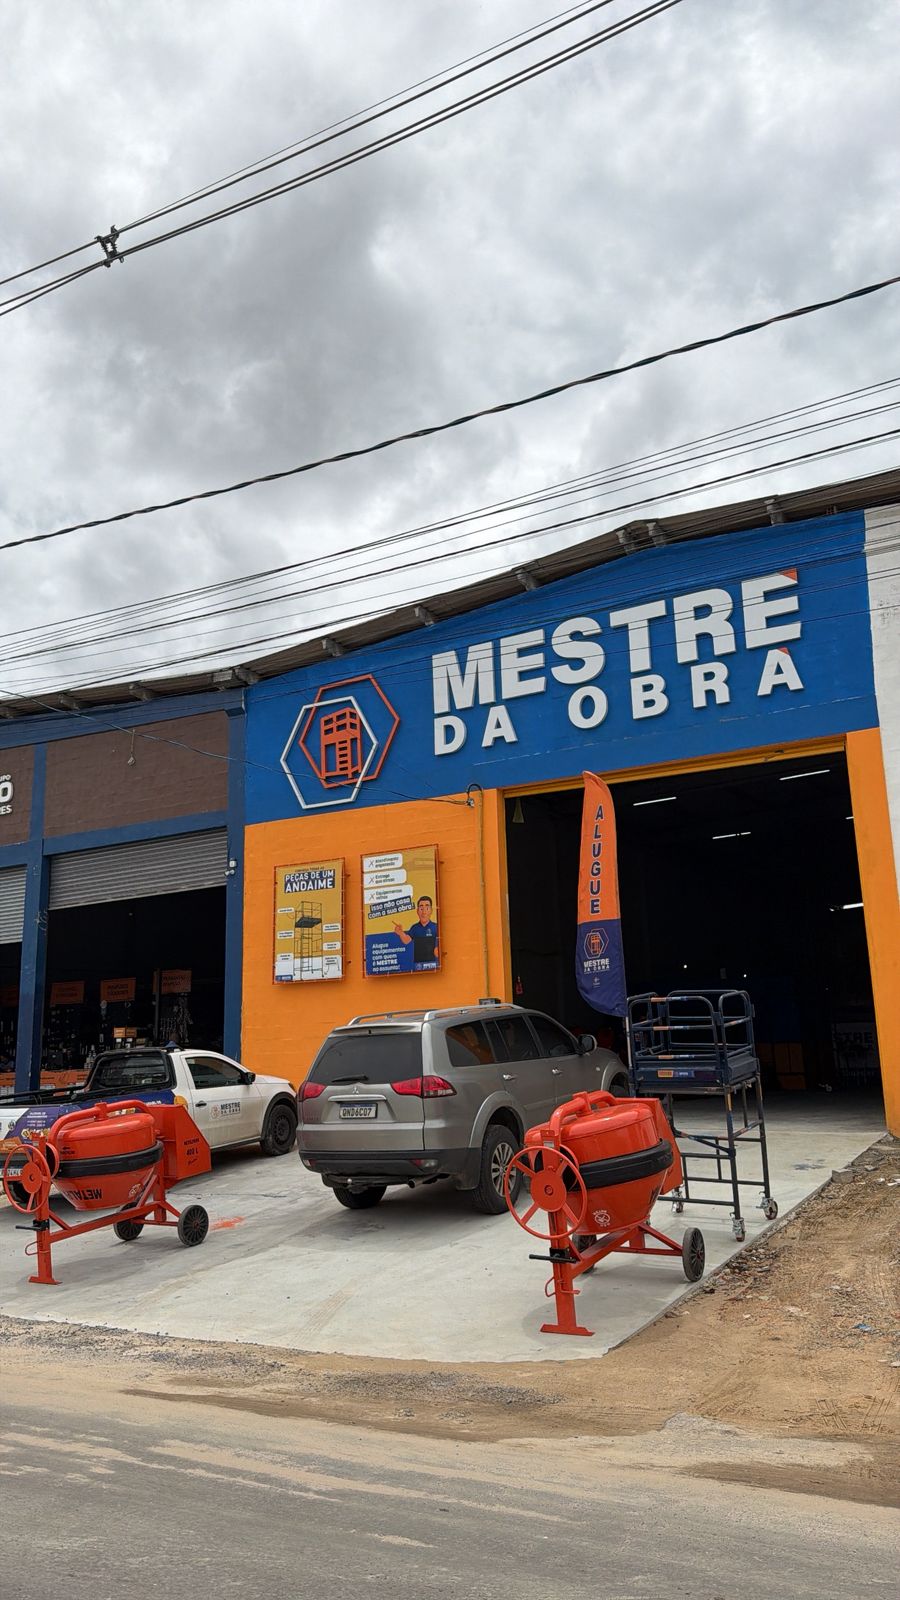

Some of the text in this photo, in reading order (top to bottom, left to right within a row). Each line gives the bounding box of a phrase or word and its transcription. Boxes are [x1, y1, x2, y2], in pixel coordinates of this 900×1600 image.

[432, 568, 802, 715] MESTRE
[433, 647, 805, 756] DA OBRA
[589, 804, 605, 916] ALUGUE
[285, 872, 309, 882] PEÇAS
[322, 869, 334, 878] UM
[285, 878, 334, 893] ANDAIME
[383, 901, 395, 909] não
[368, 911, 382, 919] com
[583, 958, 610, 968] MESTRE
[220, 1102, 241, 1110] MESTRE
